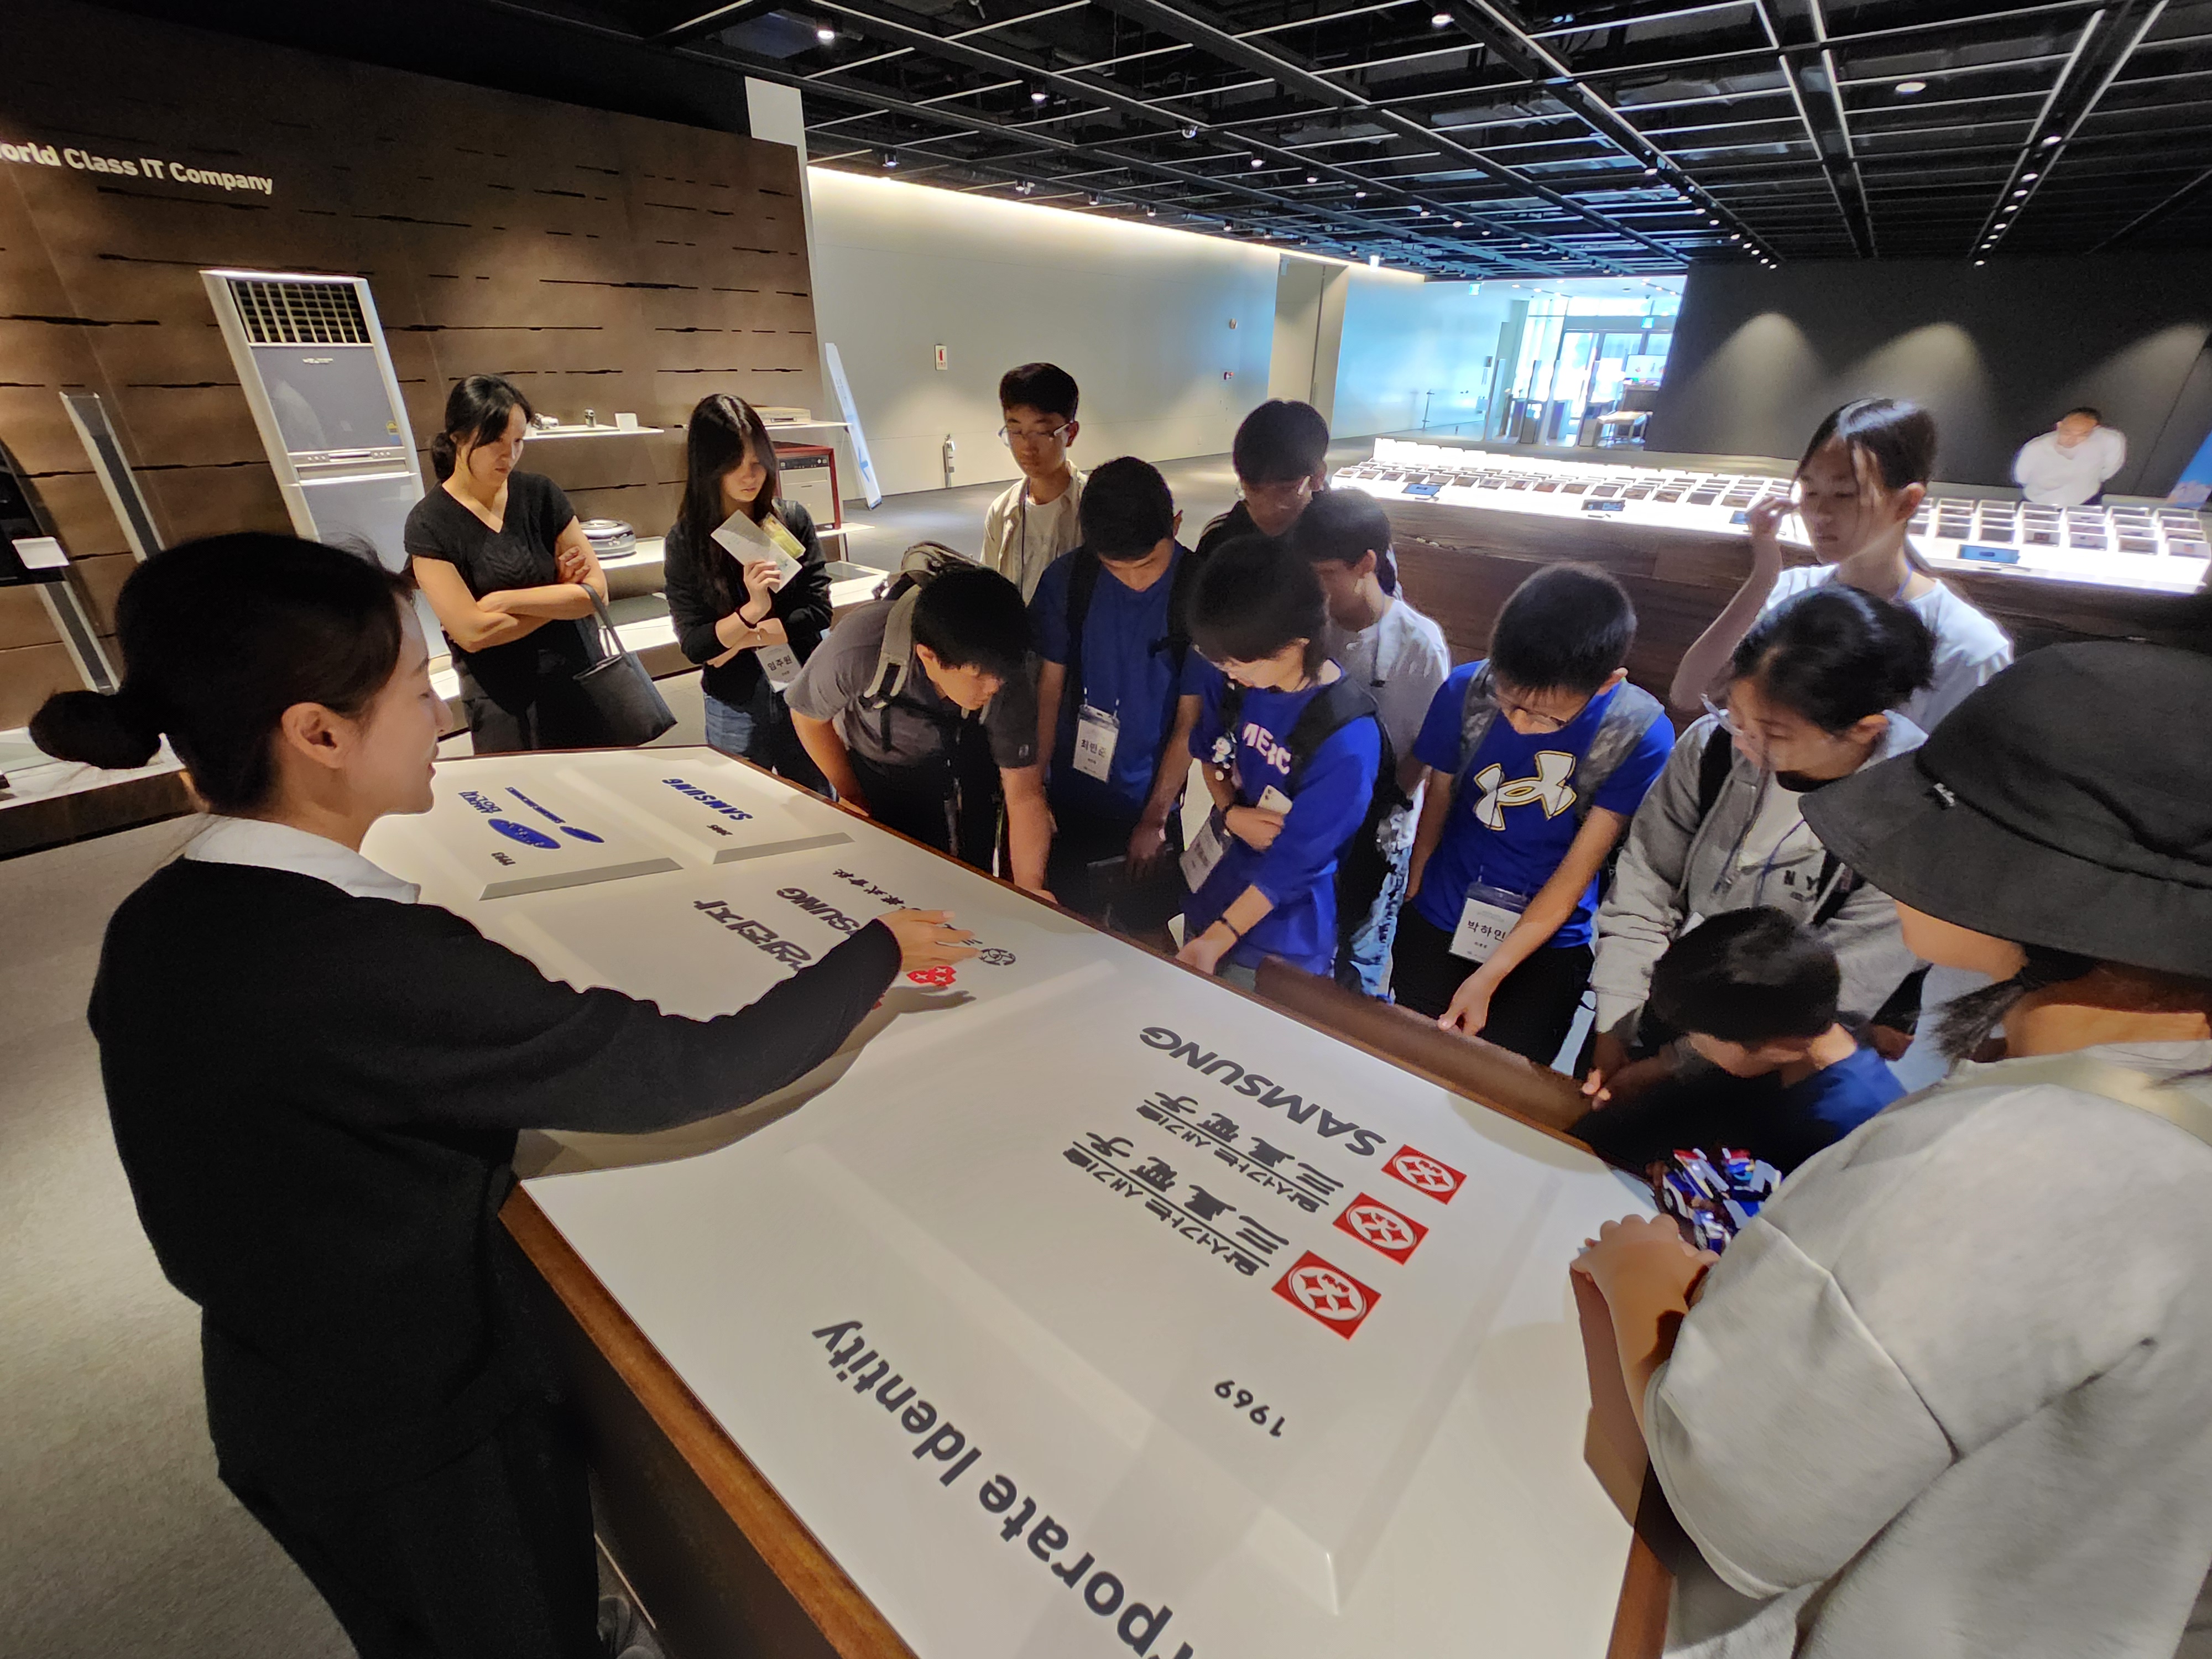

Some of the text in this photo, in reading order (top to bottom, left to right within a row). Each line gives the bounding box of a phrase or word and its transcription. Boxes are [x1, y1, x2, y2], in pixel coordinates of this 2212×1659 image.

[0, 142, 273, 195] orld Class IT Company
[661, 779, 754, 820] SAMSUNG
[693, 900, 812, 972] 성전자
[776, 887, 860, 936] SUNG
[1139, 1027, 1387, 1156] SAMSUNG
[811, 1321, 982, 1487] Identity
[1214, 1380, 1285, 1437] 1969
